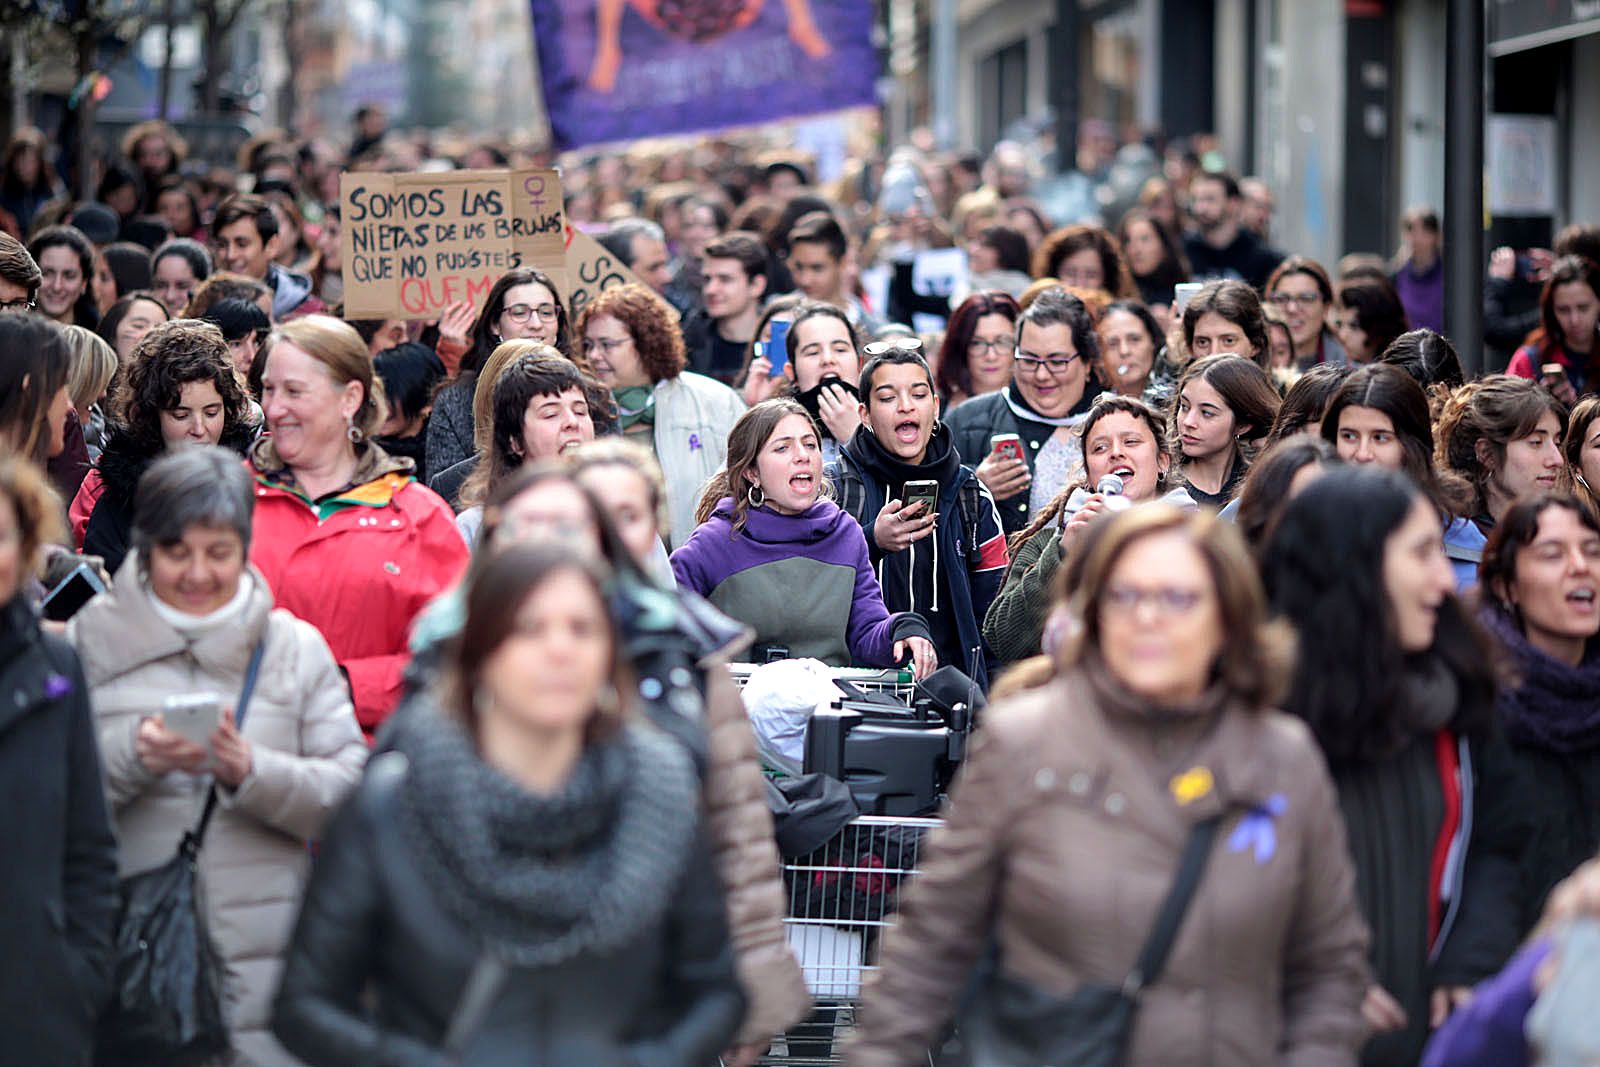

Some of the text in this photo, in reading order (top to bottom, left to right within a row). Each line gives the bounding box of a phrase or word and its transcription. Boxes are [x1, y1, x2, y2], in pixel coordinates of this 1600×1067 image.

[350, 187, 503, 221] SOMOS LAS
[436, 223, 456, 242] DE
[495, 211, 562, 239] BRUJAS
[352, 255, 392, 282] QUE
[401, 255, 427, 278] NO
[401, 274, 499, 314] QUEM
